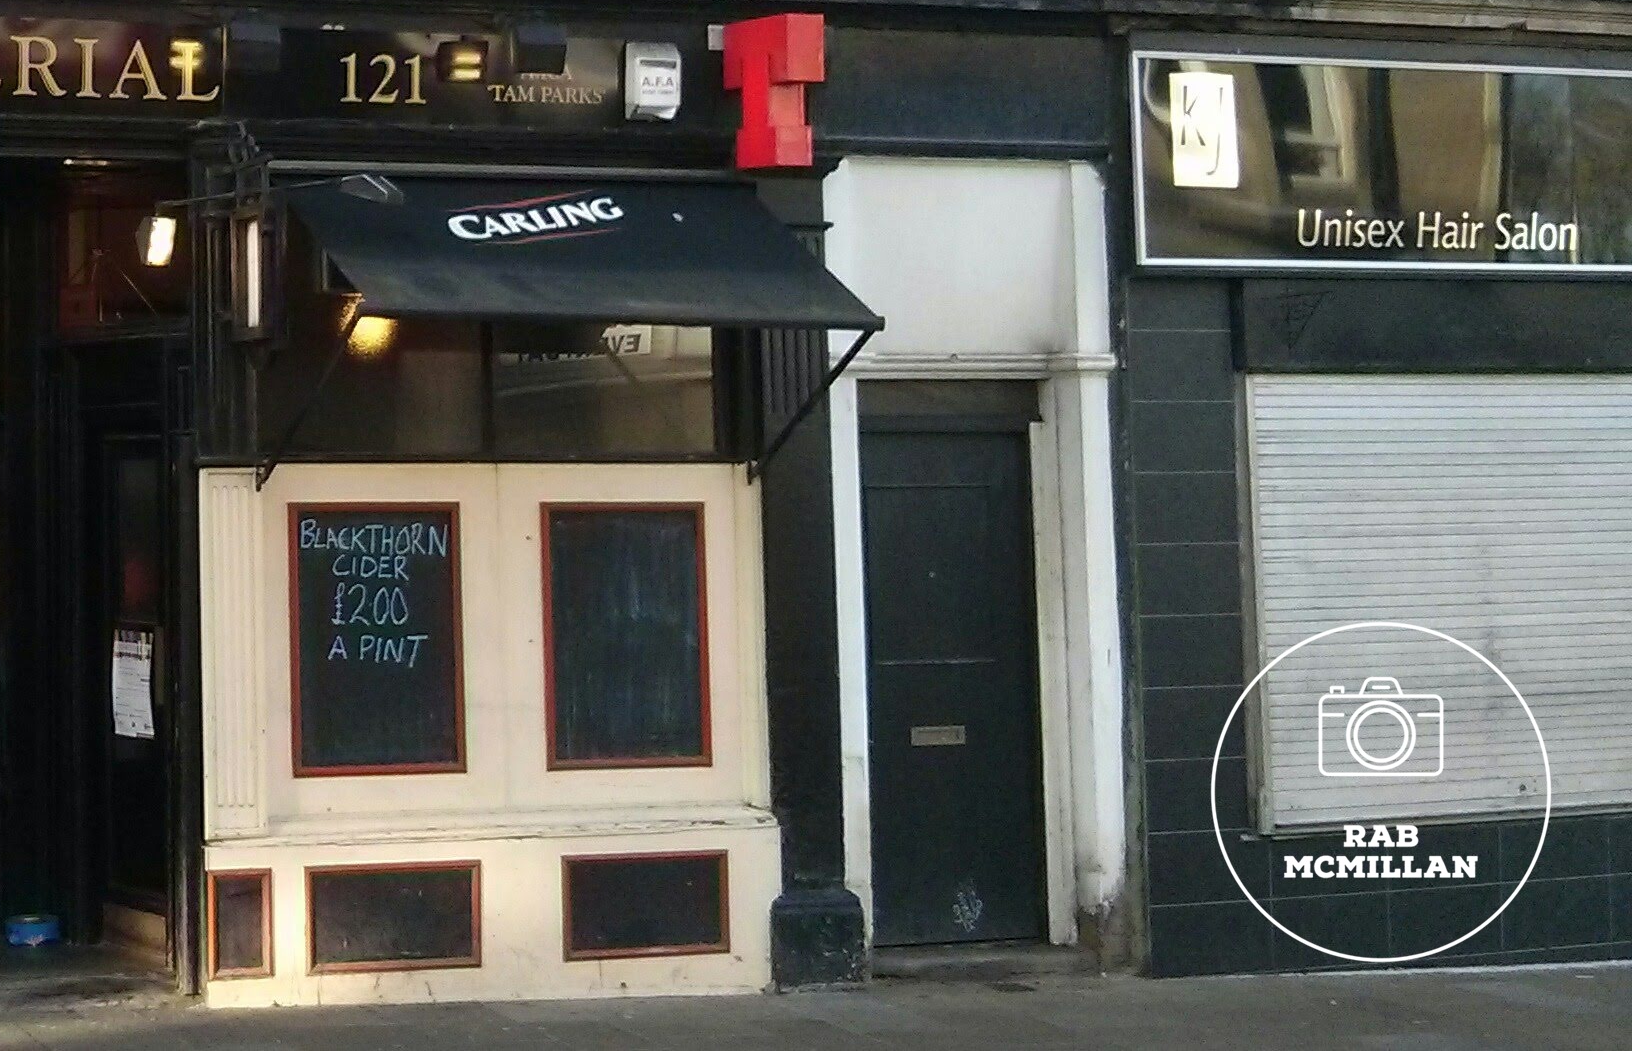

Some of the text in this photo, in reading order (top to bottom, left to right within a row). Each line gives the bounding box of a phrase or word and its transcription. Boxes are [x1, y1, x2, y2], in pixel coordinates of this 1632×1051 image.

[339, 52, 427, 105] 121
[447, 197, 624, 240] CARLING
[1296, 208, 1580, 252] Unisex Hair Salon
[299, 518, 448, 558] BLACKTHORN
[331, 553, 410, 582] CIDER
[327, 634, 429, 669] A PINT
